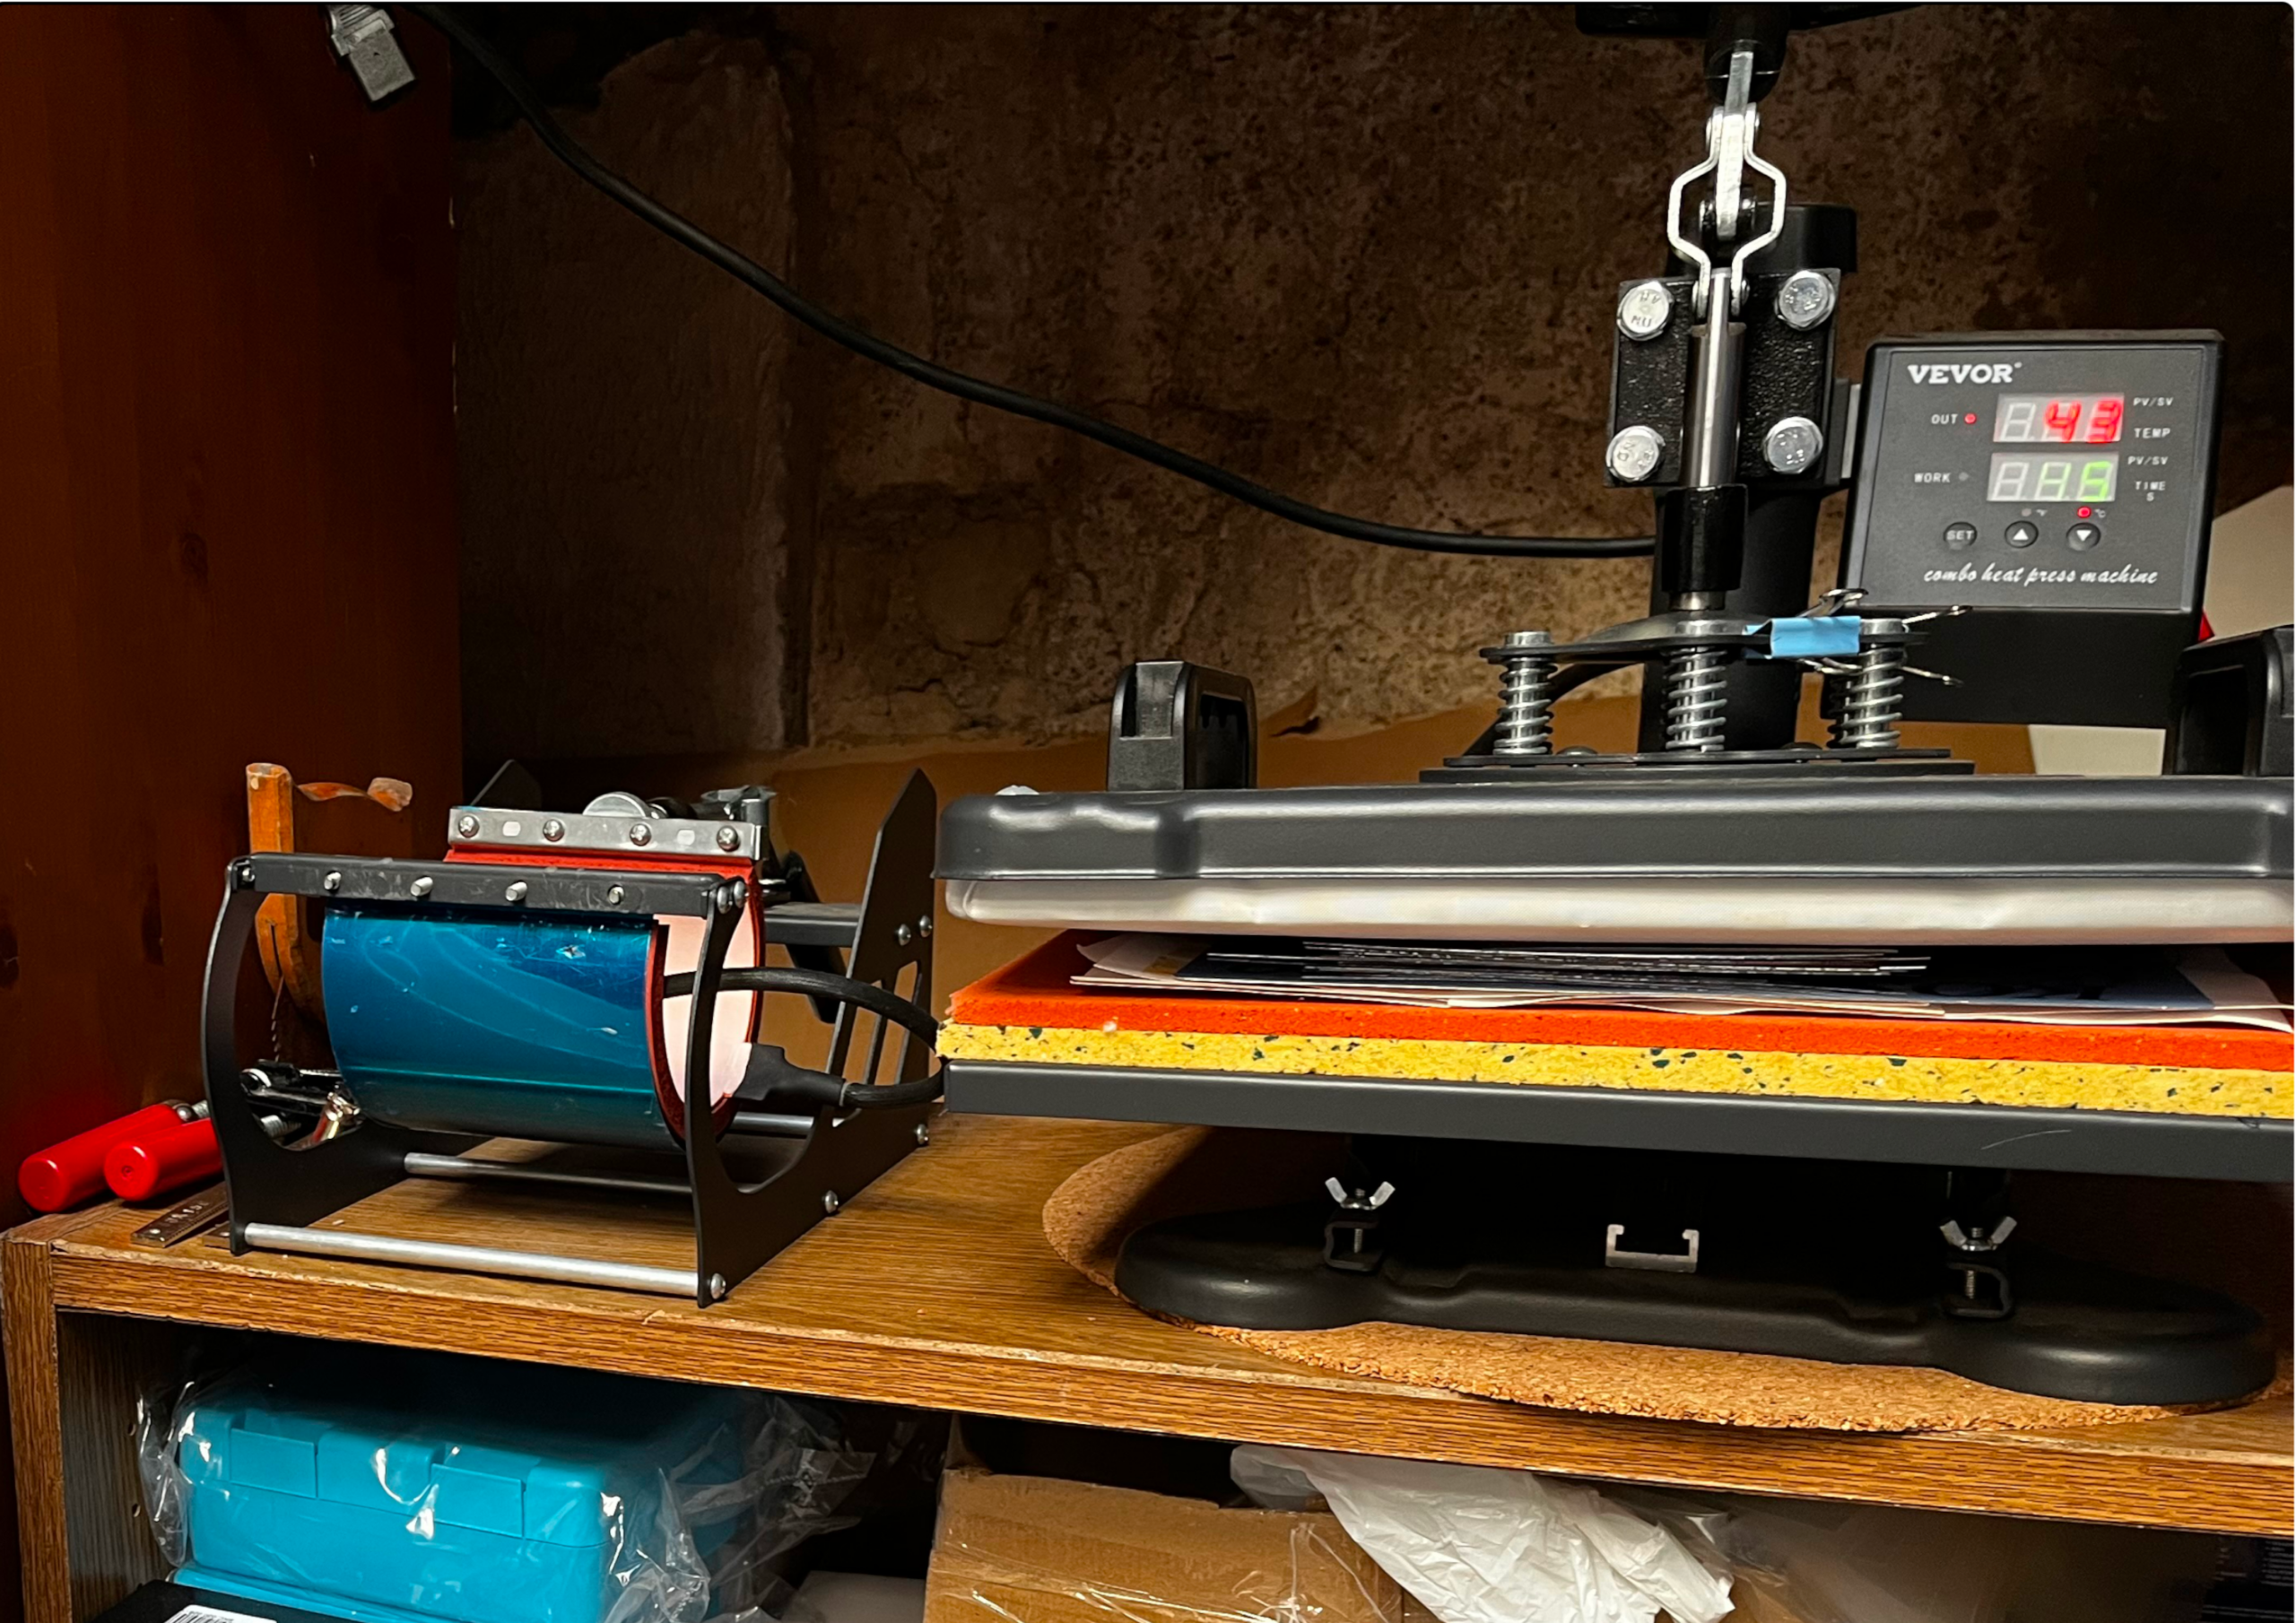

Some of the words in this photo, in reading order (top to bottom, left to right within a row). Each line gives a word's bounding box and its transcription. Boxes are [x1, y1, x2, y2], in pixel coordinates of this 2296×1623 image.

[2133, 396, 2174, 407] PV/SV
[1931, 413, 1959, 425] OUT
[2043, 399, 2125, 443] 43
[2134, 427, 2171, 439] TEMP
[2127, 455, 2169, 466] PV/SV
[1914, 472, 1952, 484] WORK
[2135, 481, 2167, 491] TIME
[2146, 491, 2155, 502] S
[1945, 529, 1975, 541] SET
[1923, 561, 1978, 583] combo
[1980, 561, 2025, 583] heat
[2022, 567, 2077, 587] press
[2079, 563, 2159, 585] machine
